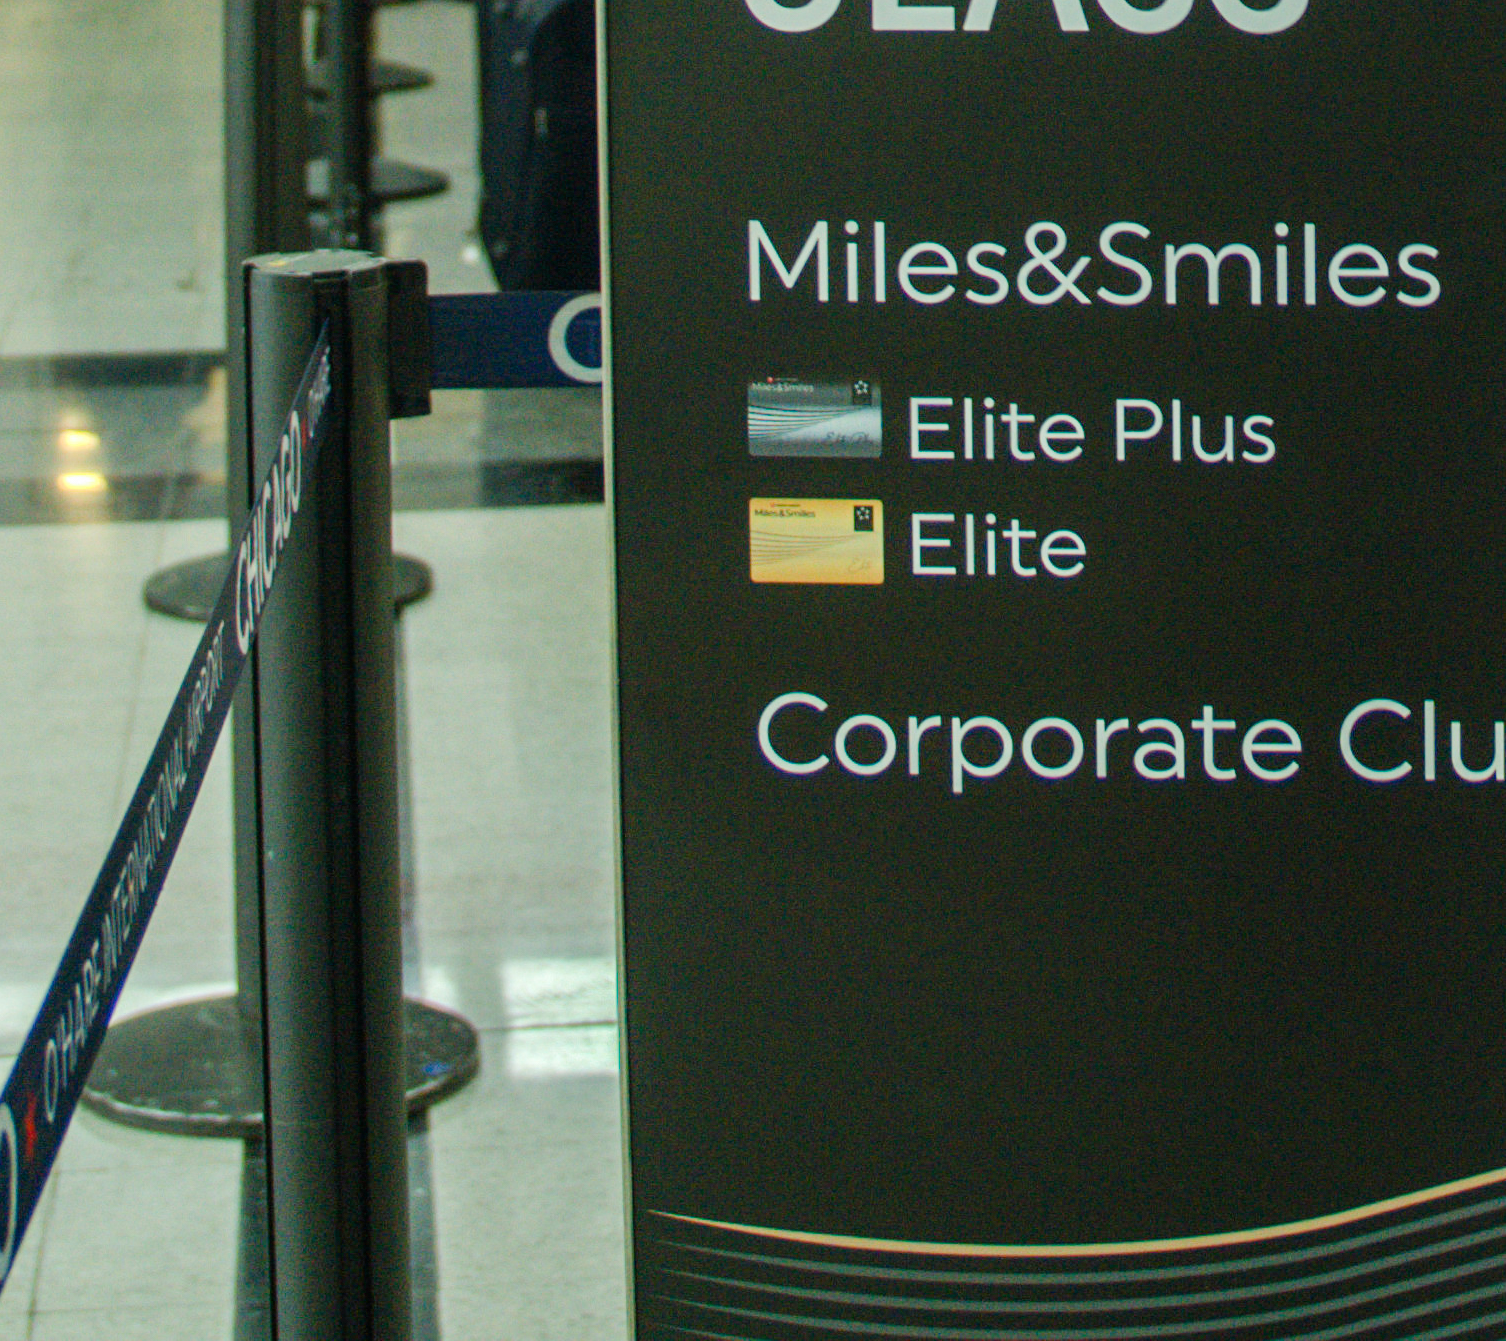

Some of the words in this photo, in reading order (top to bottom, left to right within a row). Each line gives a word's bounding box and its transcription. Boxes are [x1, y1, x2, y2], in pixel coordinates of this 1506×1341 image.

[745, 219, 1443, 309] Miles&Smiles
[906, 395, 1086, 463] Elite
[1114, 397, 1277, 465] Plus
[909, 511, 1088, 579] Elite
[100, 725, 189, 993] INTERNATIONAL
[186, 619, 225, 769] AIRPORT
[235, 409, 303, 656] CHICAGO
[757, 691, 1302, 795] Corporate
